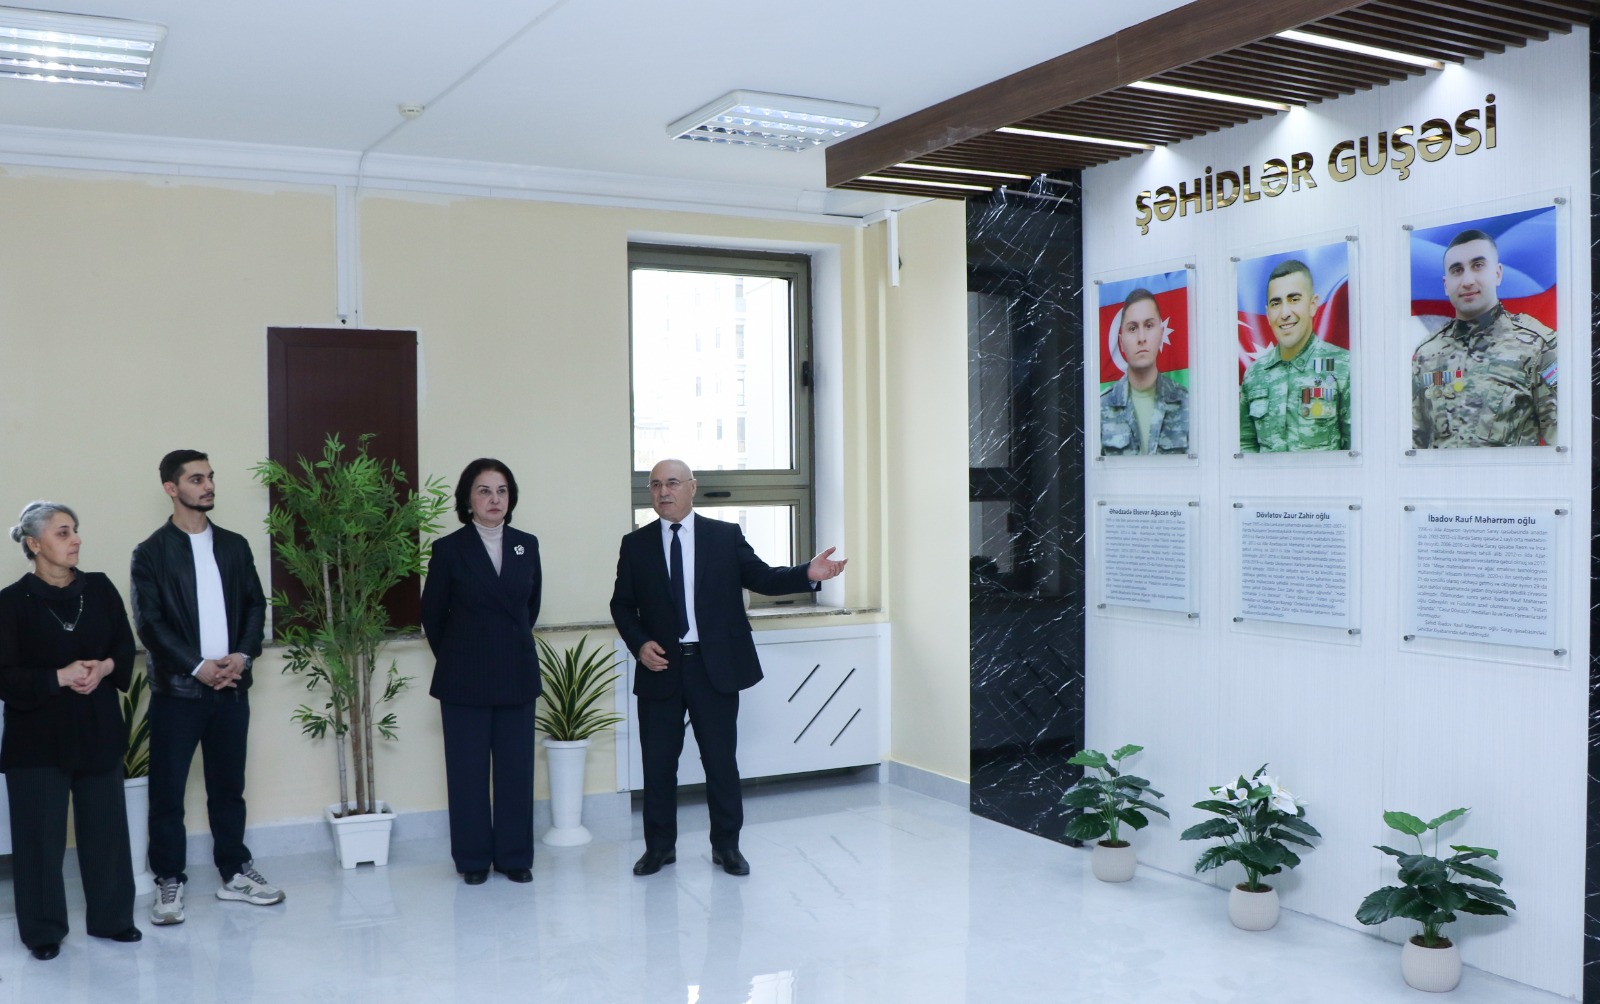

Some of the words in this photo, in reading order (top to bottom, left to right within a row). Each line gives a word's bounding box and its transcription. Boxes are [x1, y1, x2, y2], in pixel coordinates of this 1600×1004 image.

[1135, 151, 1318, 236] ŞƏHİDLƏR
[1327, 93, 1497, 182] GUŞƏSİ
[1169, 510, 1182, 518] oğlu
[1283, 511, 1297, 519] Zaur
[1298, 512, 1314, 520] Zahir
[1315, 512, 1330, 522] oğlu
[1455, 515, 1473, 524] Rauf
[1474, 515, 1515, 525] Məhərrəm
[1517, 516, 1536, 527] oğlu
